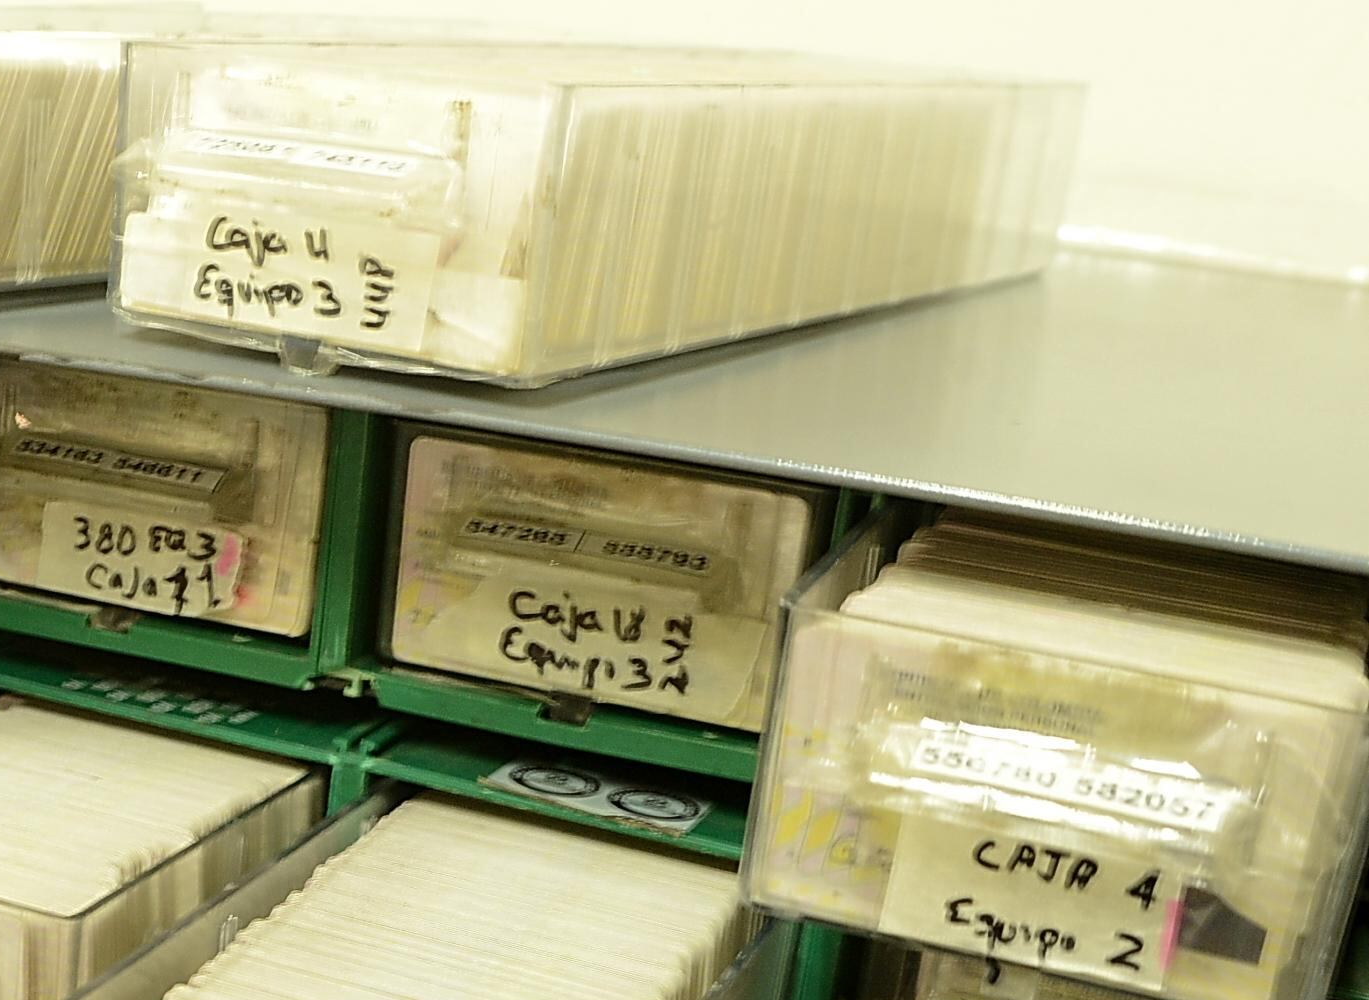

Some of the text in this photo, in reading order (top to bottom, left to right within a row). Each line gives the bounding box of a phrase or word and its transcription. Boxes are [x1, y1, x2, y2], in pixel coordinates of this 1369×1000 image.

[204, 214, 289, 269] Caja
[192, 261, 343, 319] Equipo 3
[72, 515, 138, 557] 380
[188, 531, 217, 562] 3
[507, 588, 603, 643] Caja
[621, 656, 653, 691] 3
[972, 840, 1164, 911] CAJA 4
[1105, 932, 1146, 975] 2
